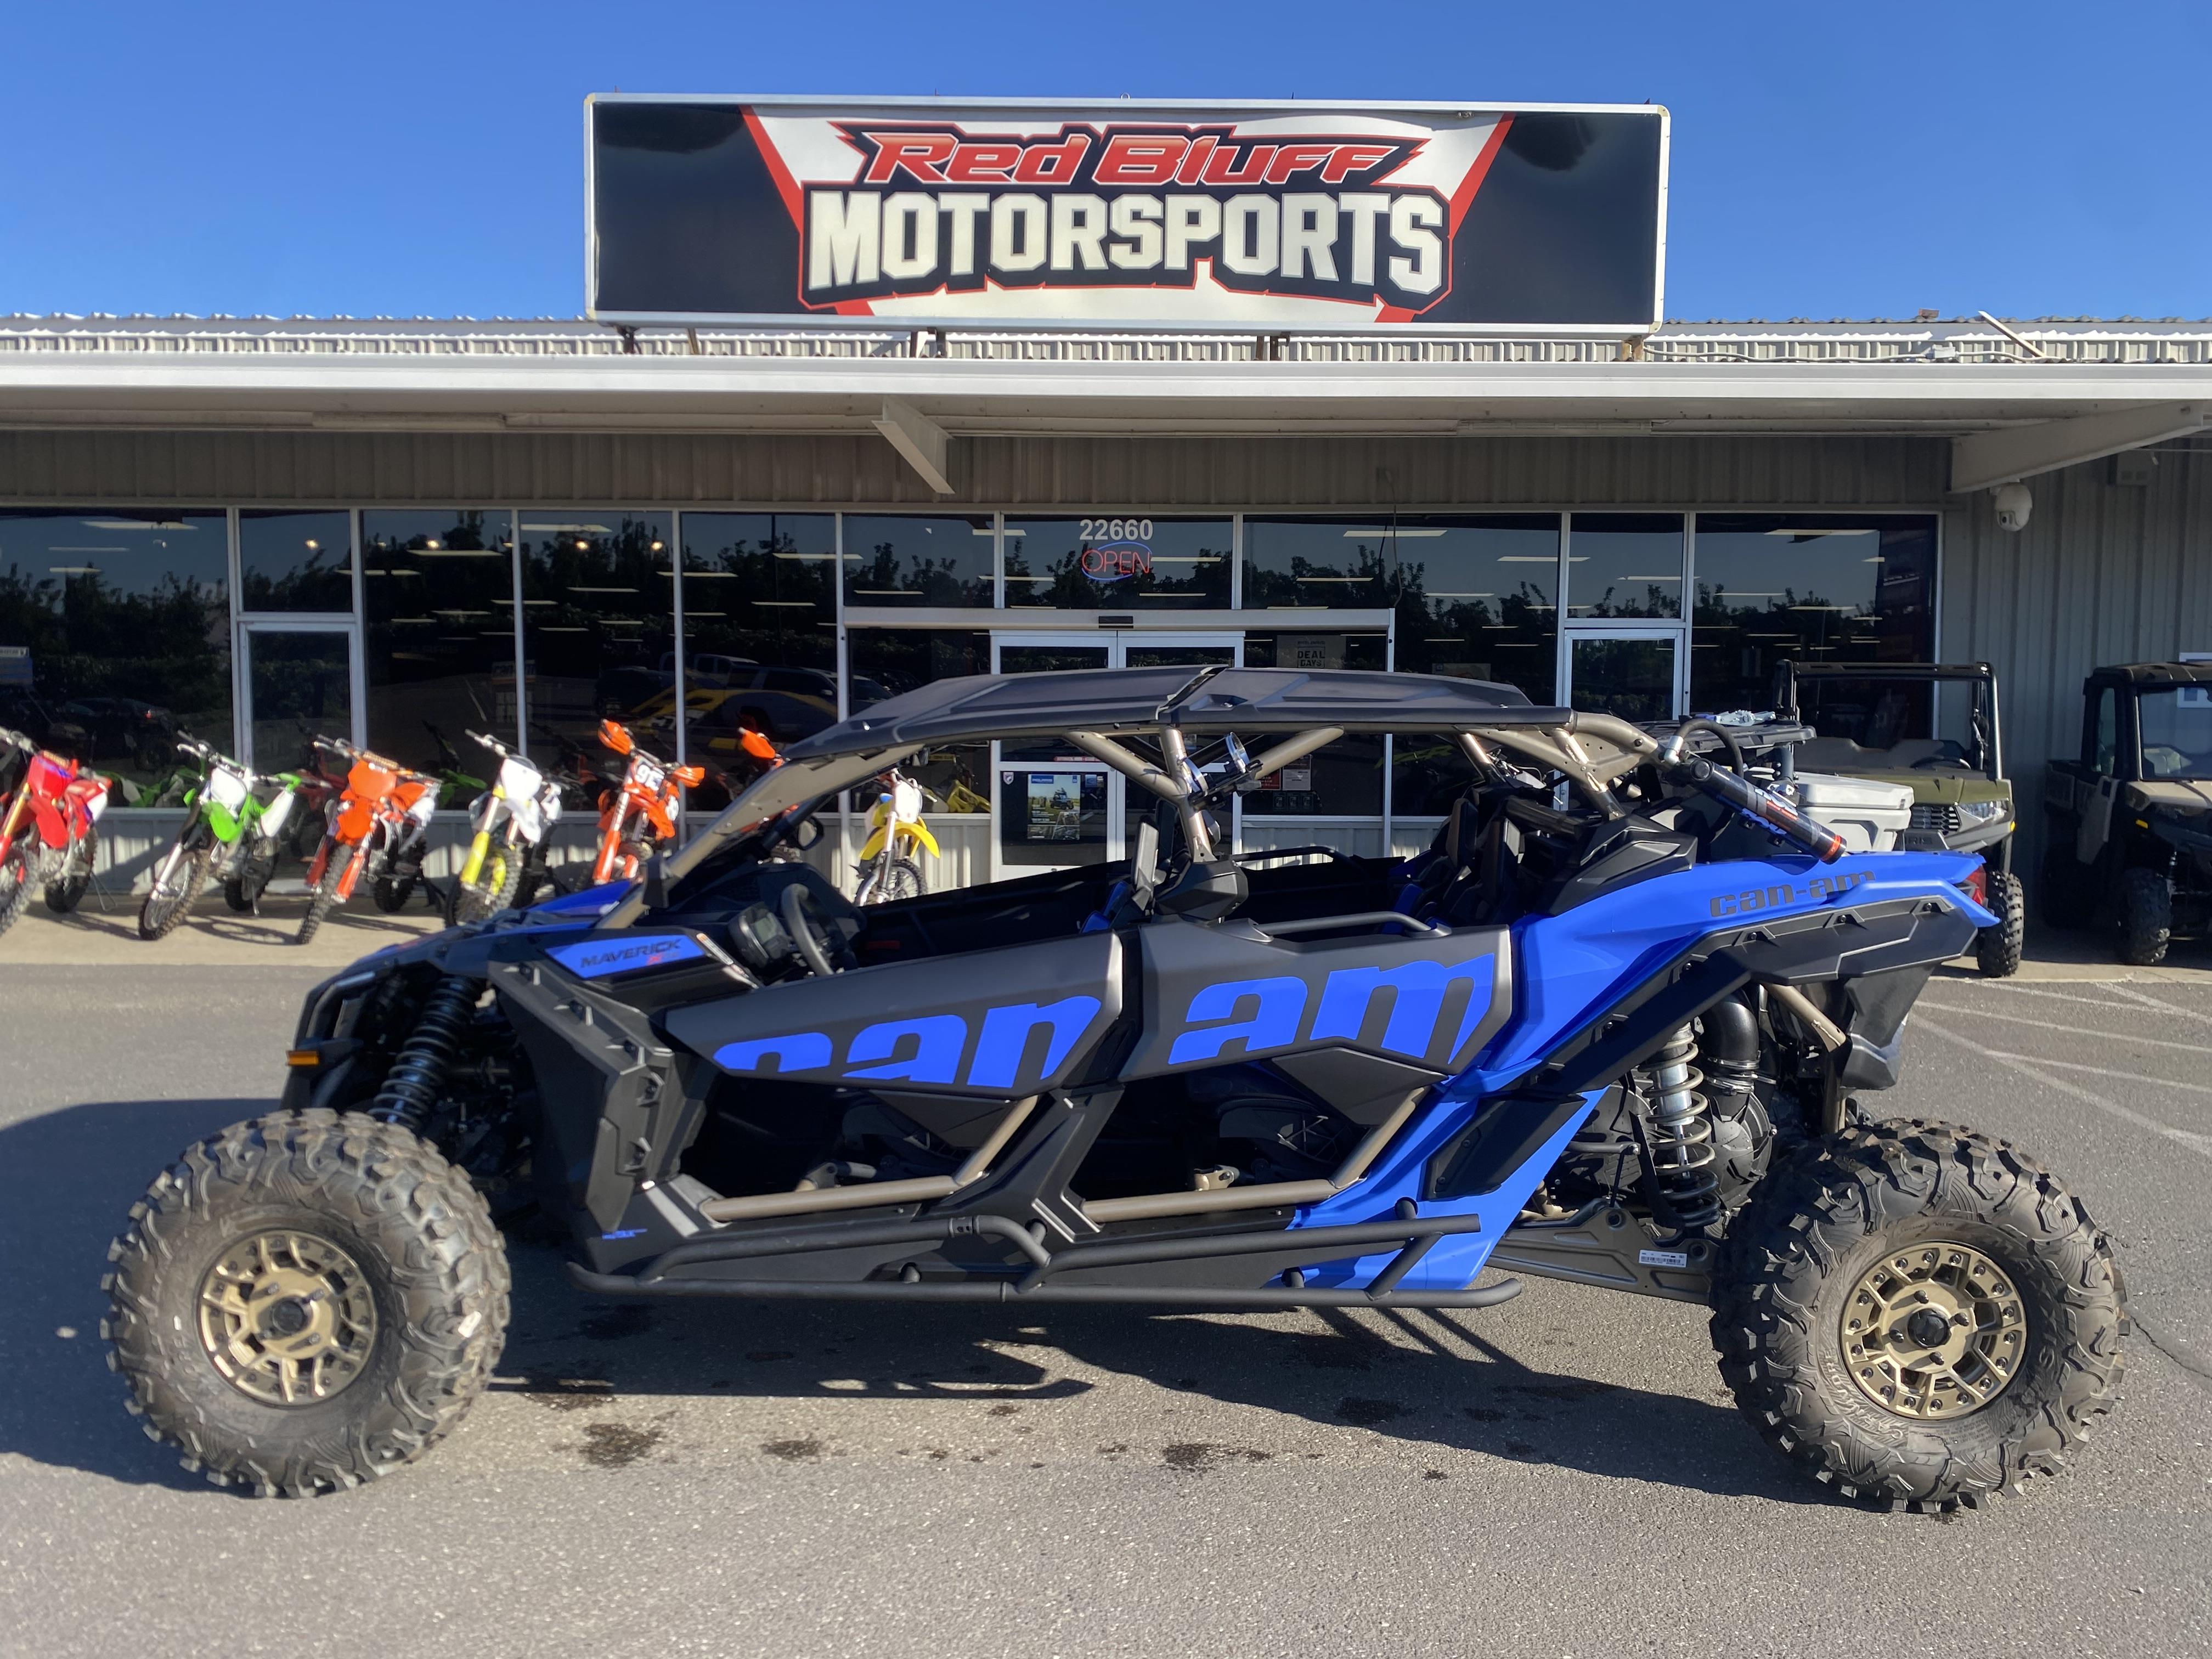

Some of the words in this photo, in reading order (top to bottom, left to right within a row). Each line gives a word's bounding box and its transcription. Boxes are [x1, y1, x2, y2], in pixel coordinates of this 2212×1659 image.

[861, 132, 1092, 184] Red
[808, 190, 1443, 295] MOTORSPORTS
[1080, 519, 1153, 540] 22660
[1081, 549, 1150, 574] OPEN
[1297, 651, 1325, 659] DEAL
[1709, 870, 1876, 917] can-am
[580, 939, 682, 968] MAVERICK
